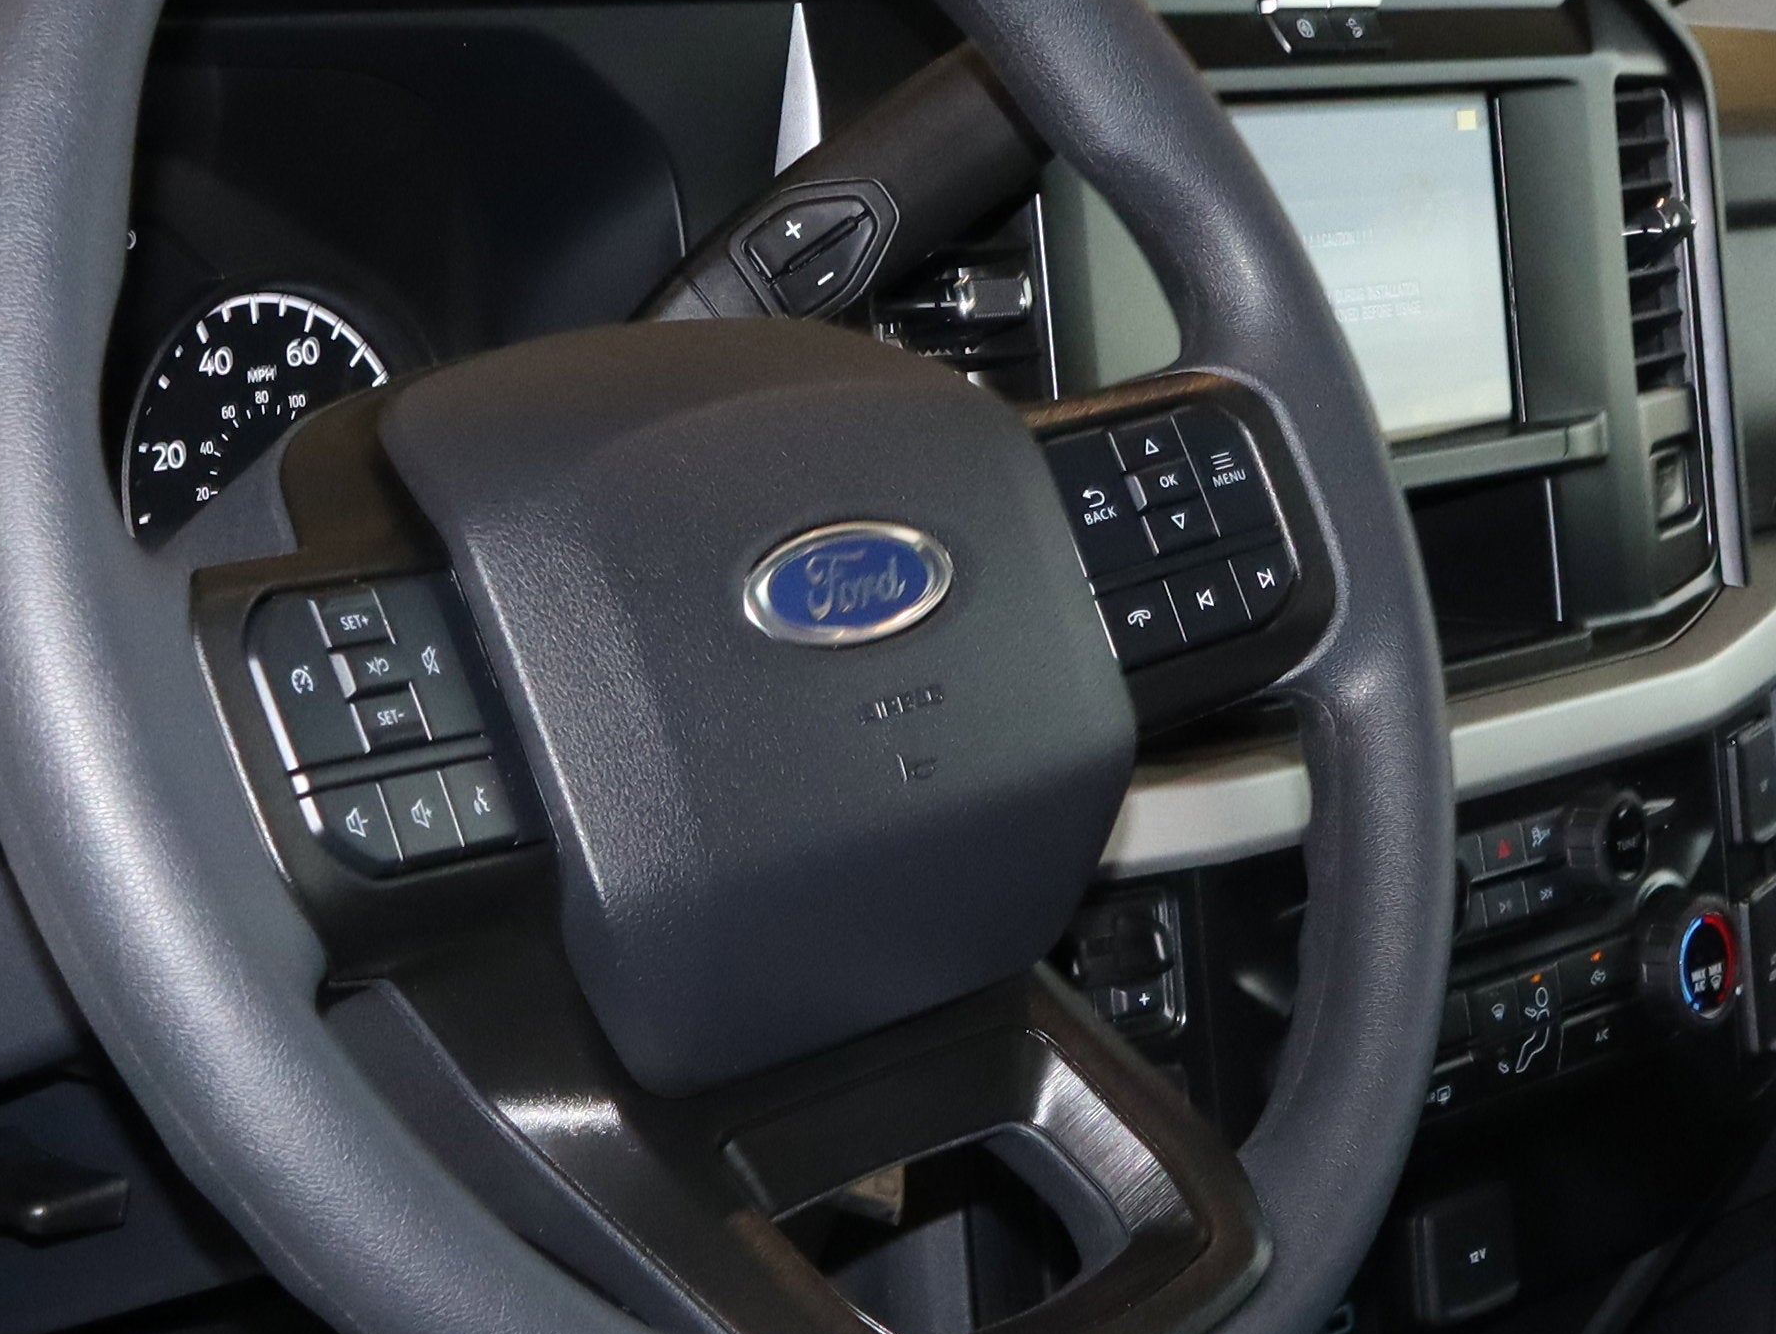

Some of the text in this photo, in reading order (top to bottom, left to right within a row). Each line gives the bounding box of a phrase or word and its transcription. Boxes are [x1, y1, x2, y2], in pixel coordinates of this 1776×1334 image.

[286, 337, 320, 367] 60
[198, 346, 233, 376] 40
[246, 366, 277, 384] MPH
[255, 390, 270, 404] 80
[288, 393, 306, 409] 100
[221, 405, 236, 420] 60
[152, 440, 187, 472] 20
[199, 441, 214, 455] 40
[1159, 473, 1180, 488] OK
[1212, 468, 1247, 488] MENU
[196, 487, 210, 502] 20
[1083, 506, 1118, 526] BACK
[805, 547, 907, 621] Ford
[1470, 1247, 1487, 1264] 12V
